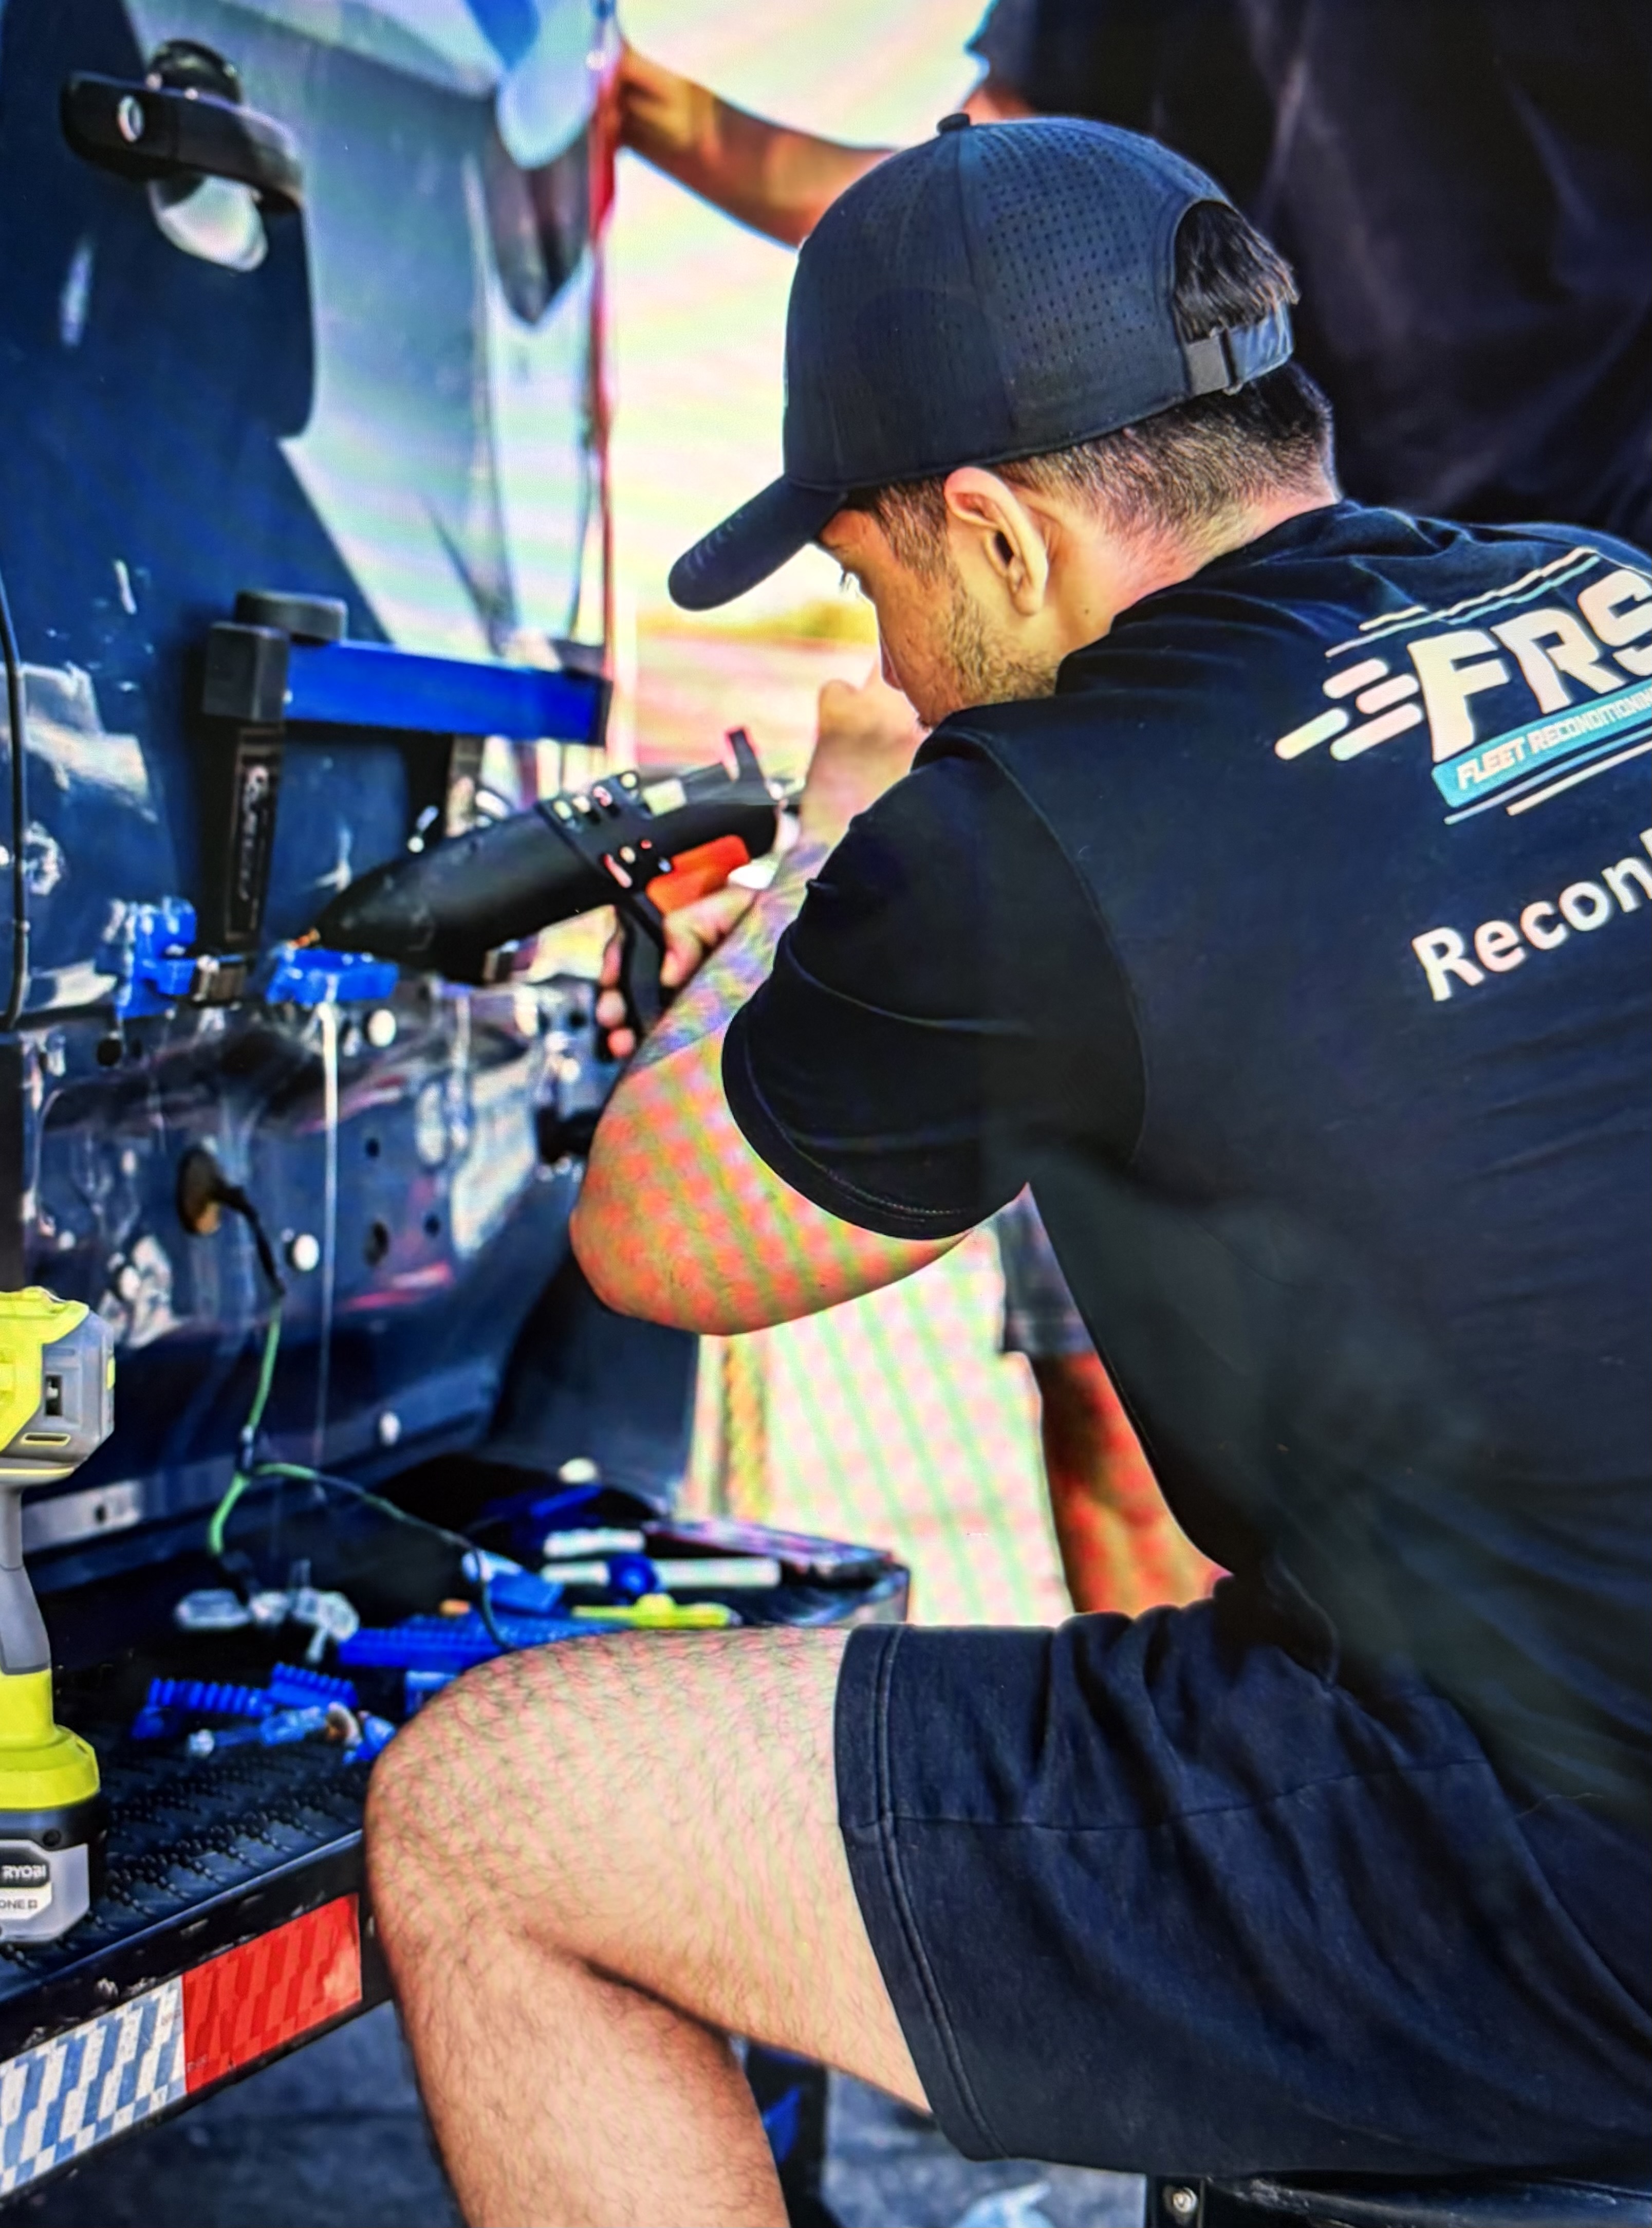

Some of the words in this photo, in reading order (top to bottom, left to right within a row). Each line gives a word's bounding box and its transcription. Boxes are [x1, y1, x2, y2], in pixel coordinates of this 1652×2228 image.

[1407, 568, 1652, 763] FRS
[1456, 736, 1526, 790] FLEET
[1411, 827, 1652, 1002] Recon
[2, 1865, 47, 1880] RYOBI
